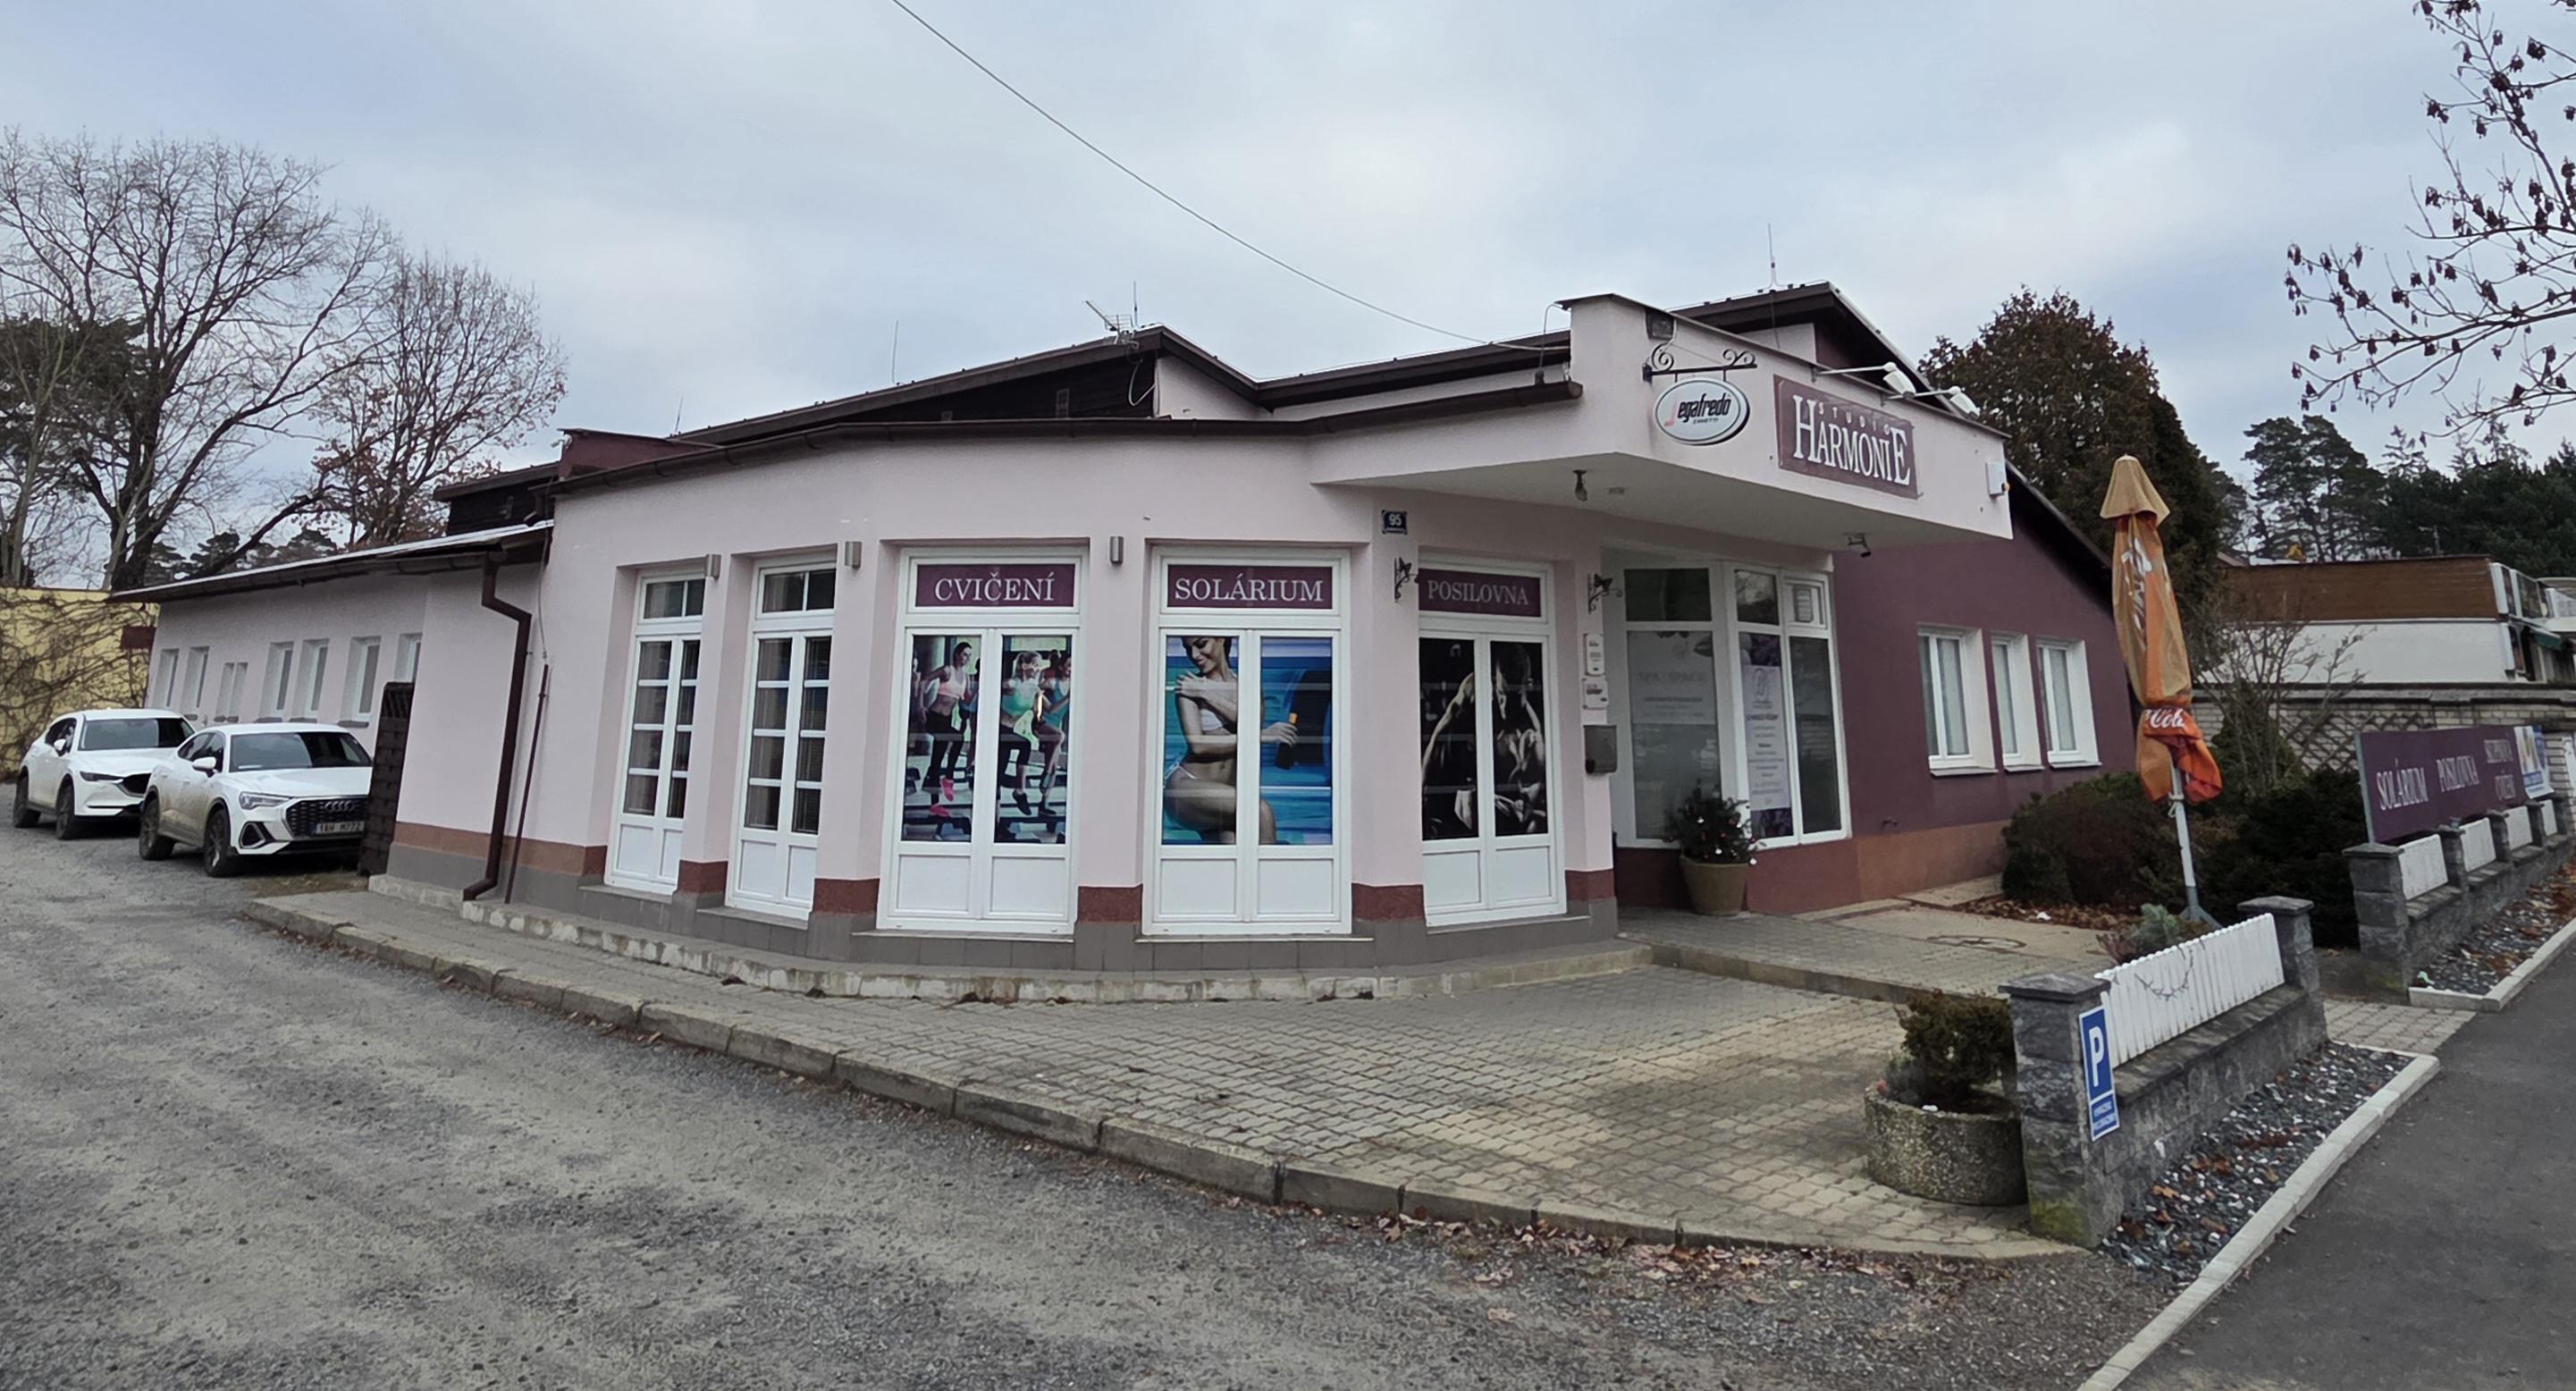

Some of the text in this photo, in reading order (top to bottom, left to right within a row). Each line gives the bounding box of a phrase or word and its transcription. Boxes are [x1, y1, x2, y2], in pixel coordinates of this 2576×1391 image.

[1818, 401, 1890, 435] STUDIO
[1792, 394, 1910, 485] HARMONIE
[1388, 513, 1402, 527] 95
[935, 571, 1056, 602] CVIČENÍ
[1174, 573, 1324, 602] SOLÁRIUM
[1427, 580, 1529, 605] POSILOVNA
[2088, 1025, 2104, 1087] P
